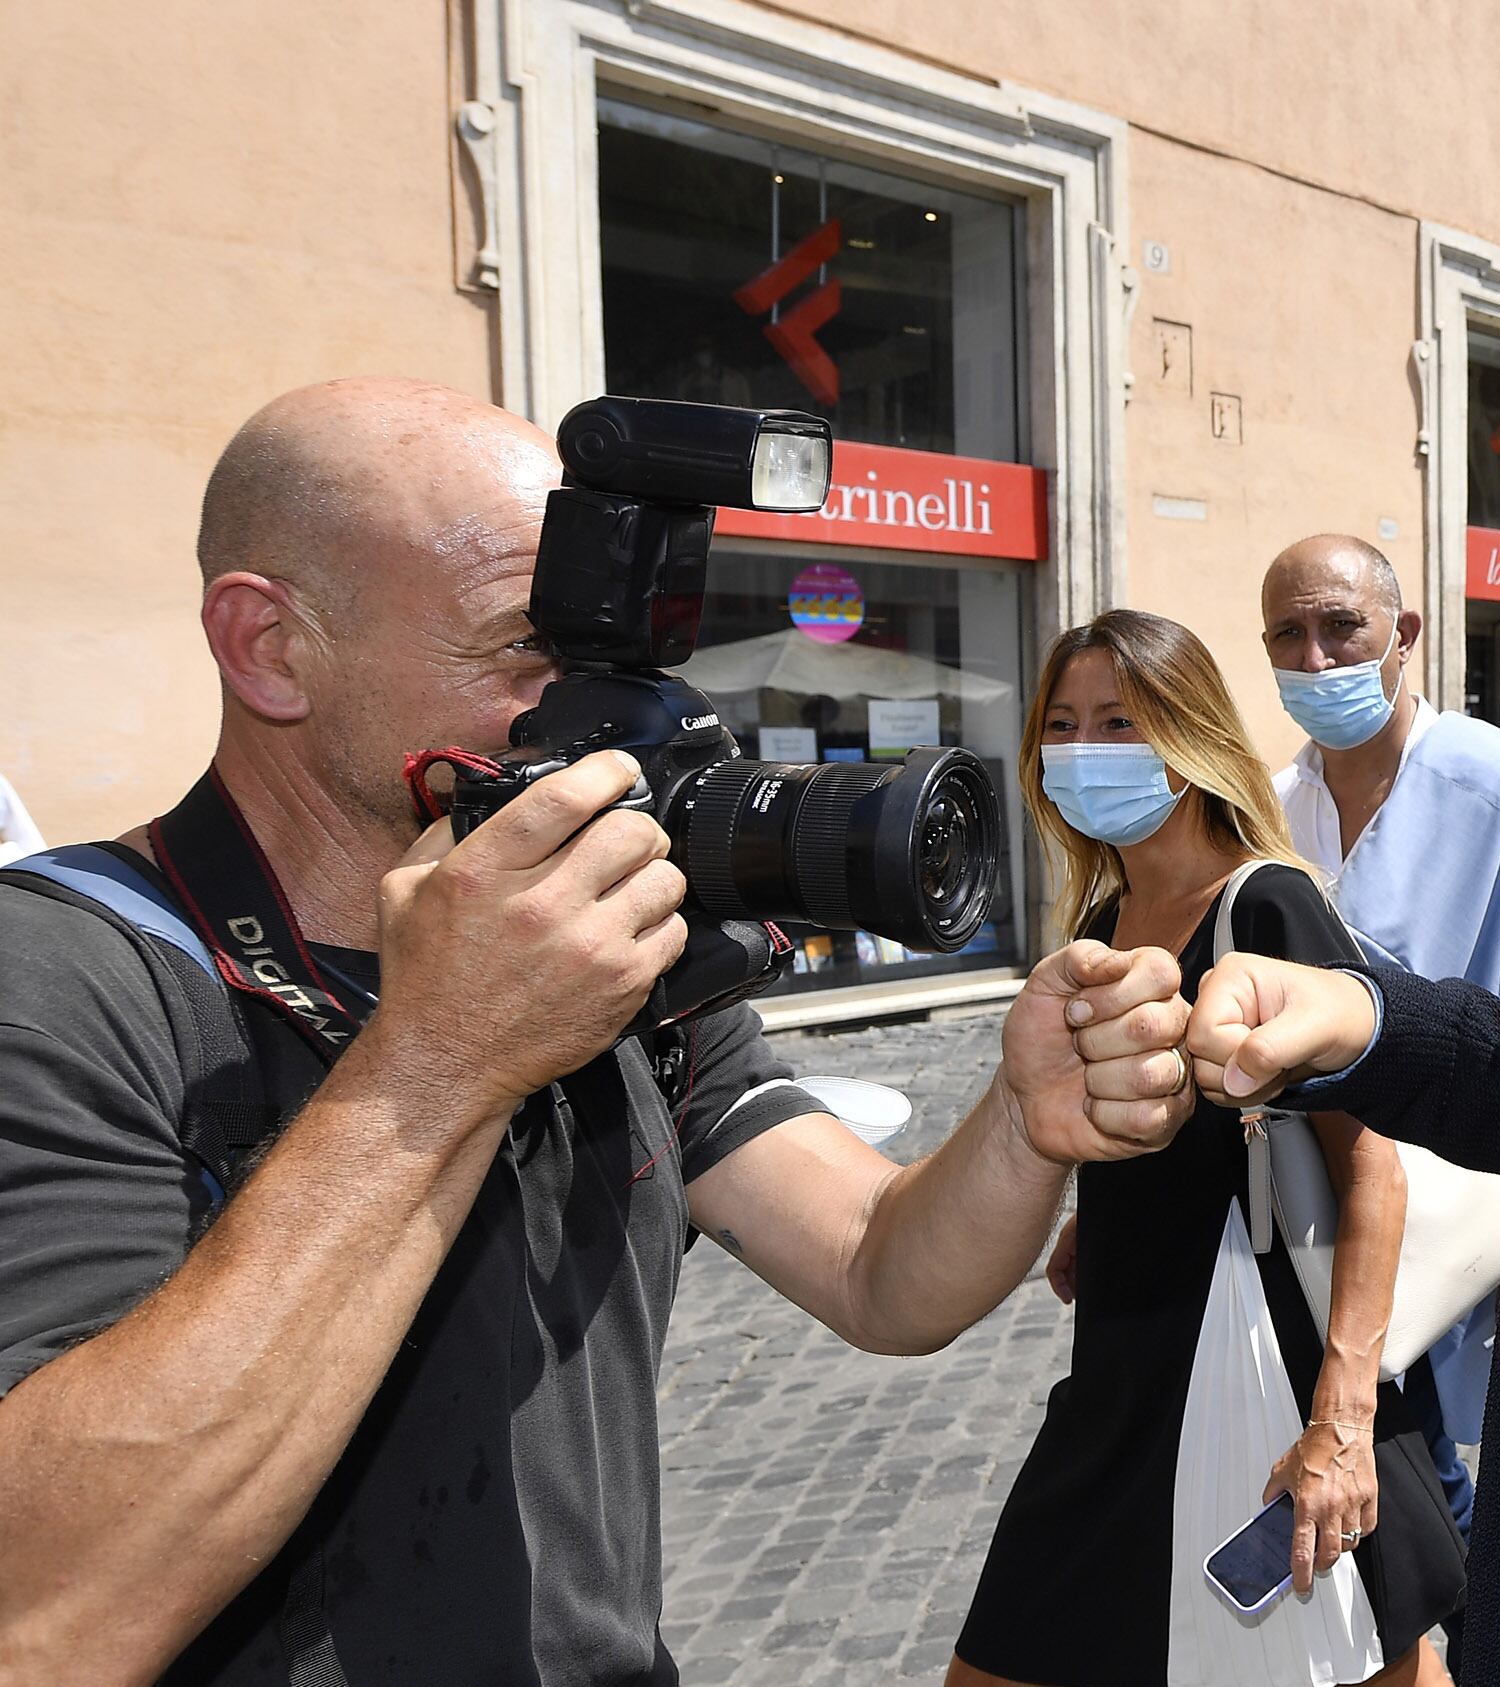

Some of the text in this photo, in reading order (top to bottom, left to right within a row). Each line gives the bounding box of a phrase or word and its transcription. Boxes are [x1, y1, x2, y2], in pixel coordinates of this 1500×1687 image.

[1151, 245, 1163, 269] 9
[806, 470, 994, 535] trinelli
[681, 713, 719, 731] Canon
[685, 800, 696, 810] 35
[759, 780, 783, 812] 16-35mm
